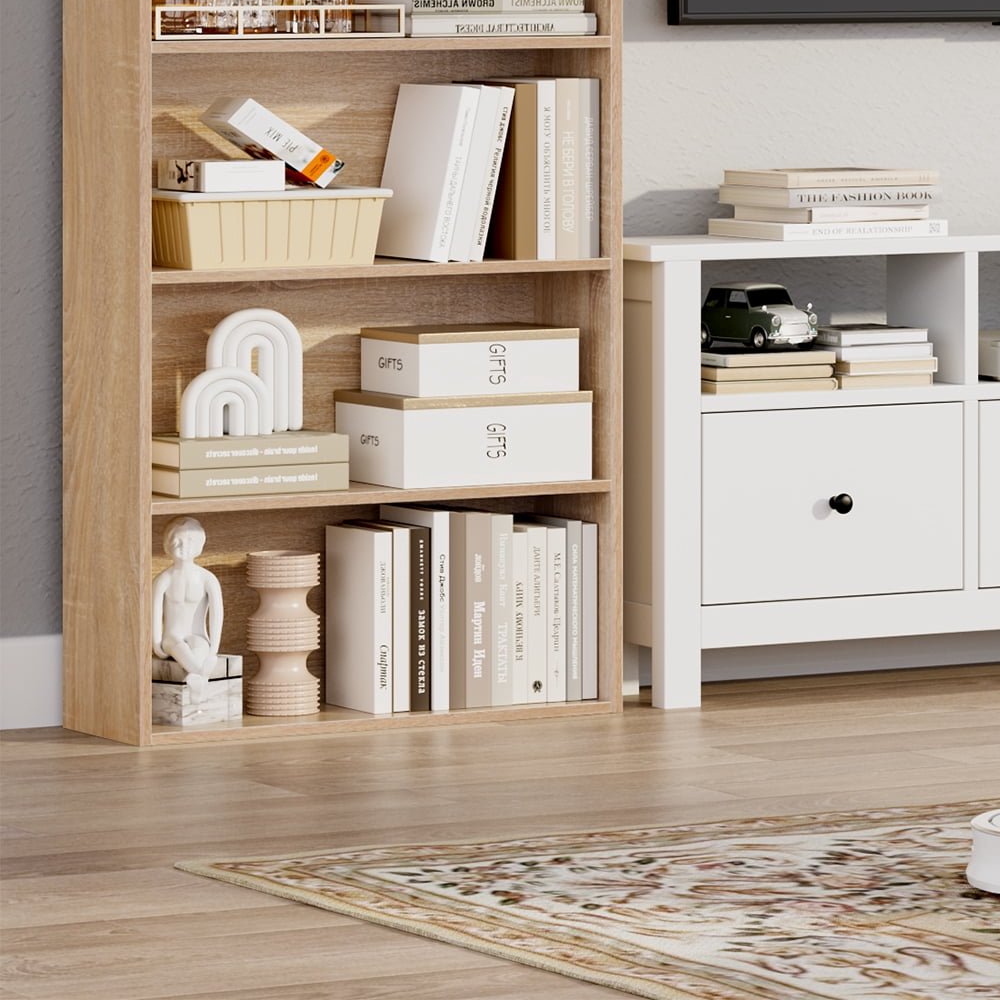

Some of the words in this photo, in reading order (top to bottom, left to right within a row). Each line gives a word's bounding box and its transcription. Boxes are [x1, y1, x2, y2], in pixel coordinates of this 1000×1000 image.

[264, 126, 282, 142] MIX
[543, 115, 551, 138] МОГУ
[562, 131, 575, 146] НЕ
[282, 139, 298, 153] PIE
[562, 148, 575, 177] БЕРИ
[796, 193, 828, 203] THE
[832, 191, 892, 202] FASHION
[896, 191, 933, 201] BOOK
[543, 197, 551, 234] МНОГОЕ
[560, 190, 575, 233] ГОЛОВУ
[812, 227, 830, 236] END
[832, 226, 842, 236] OF
[378, 356, 403, 371] GIFTS
[488, 344, 506, 386] GIFTS
[360, 434, 379, 446] GIFTS
[486, 422, 506, 460] GIFTS
[471, 601, 486, 644] Мартин
[418, 644, 425, 657] из
[472, 649, 486, 678] Иден
[497, 622, 508, 683] ТРАКТАТЫ
[377, 645, 389, 690] Спартак
